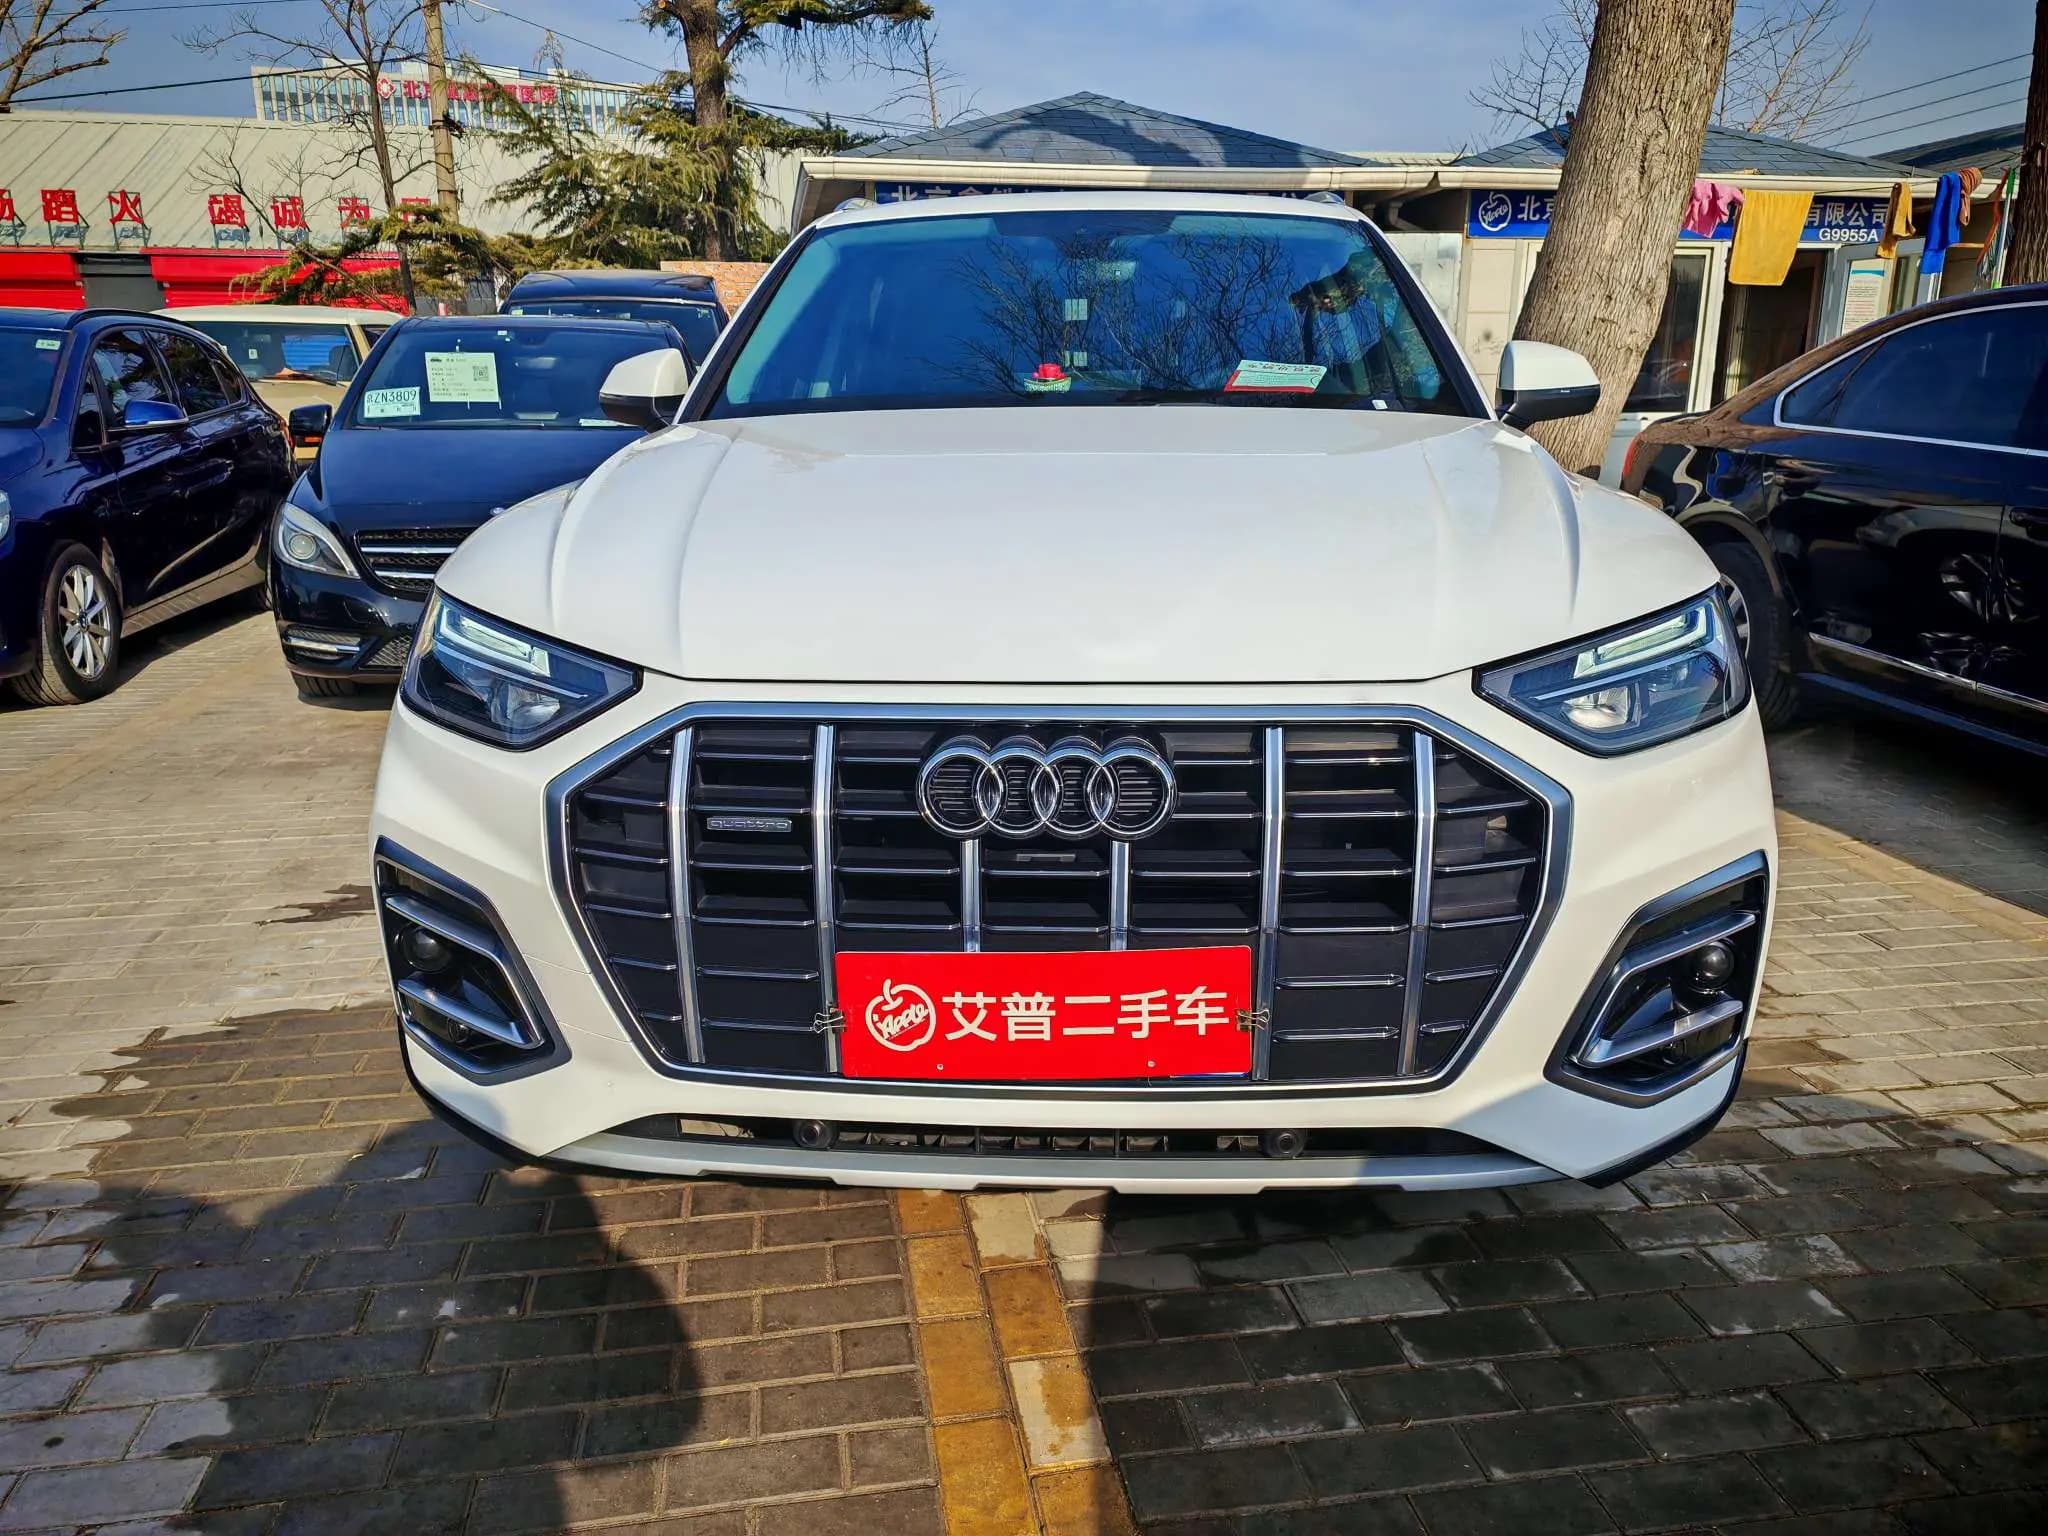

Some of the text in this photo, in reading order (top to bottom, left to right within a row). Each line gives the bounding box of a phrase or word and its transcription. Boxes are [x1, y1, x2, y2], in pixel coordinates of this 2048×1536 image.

[1819, 228, 1878, 242] G9955A
[941, 985, 1229, 1041] 艾普二手车
